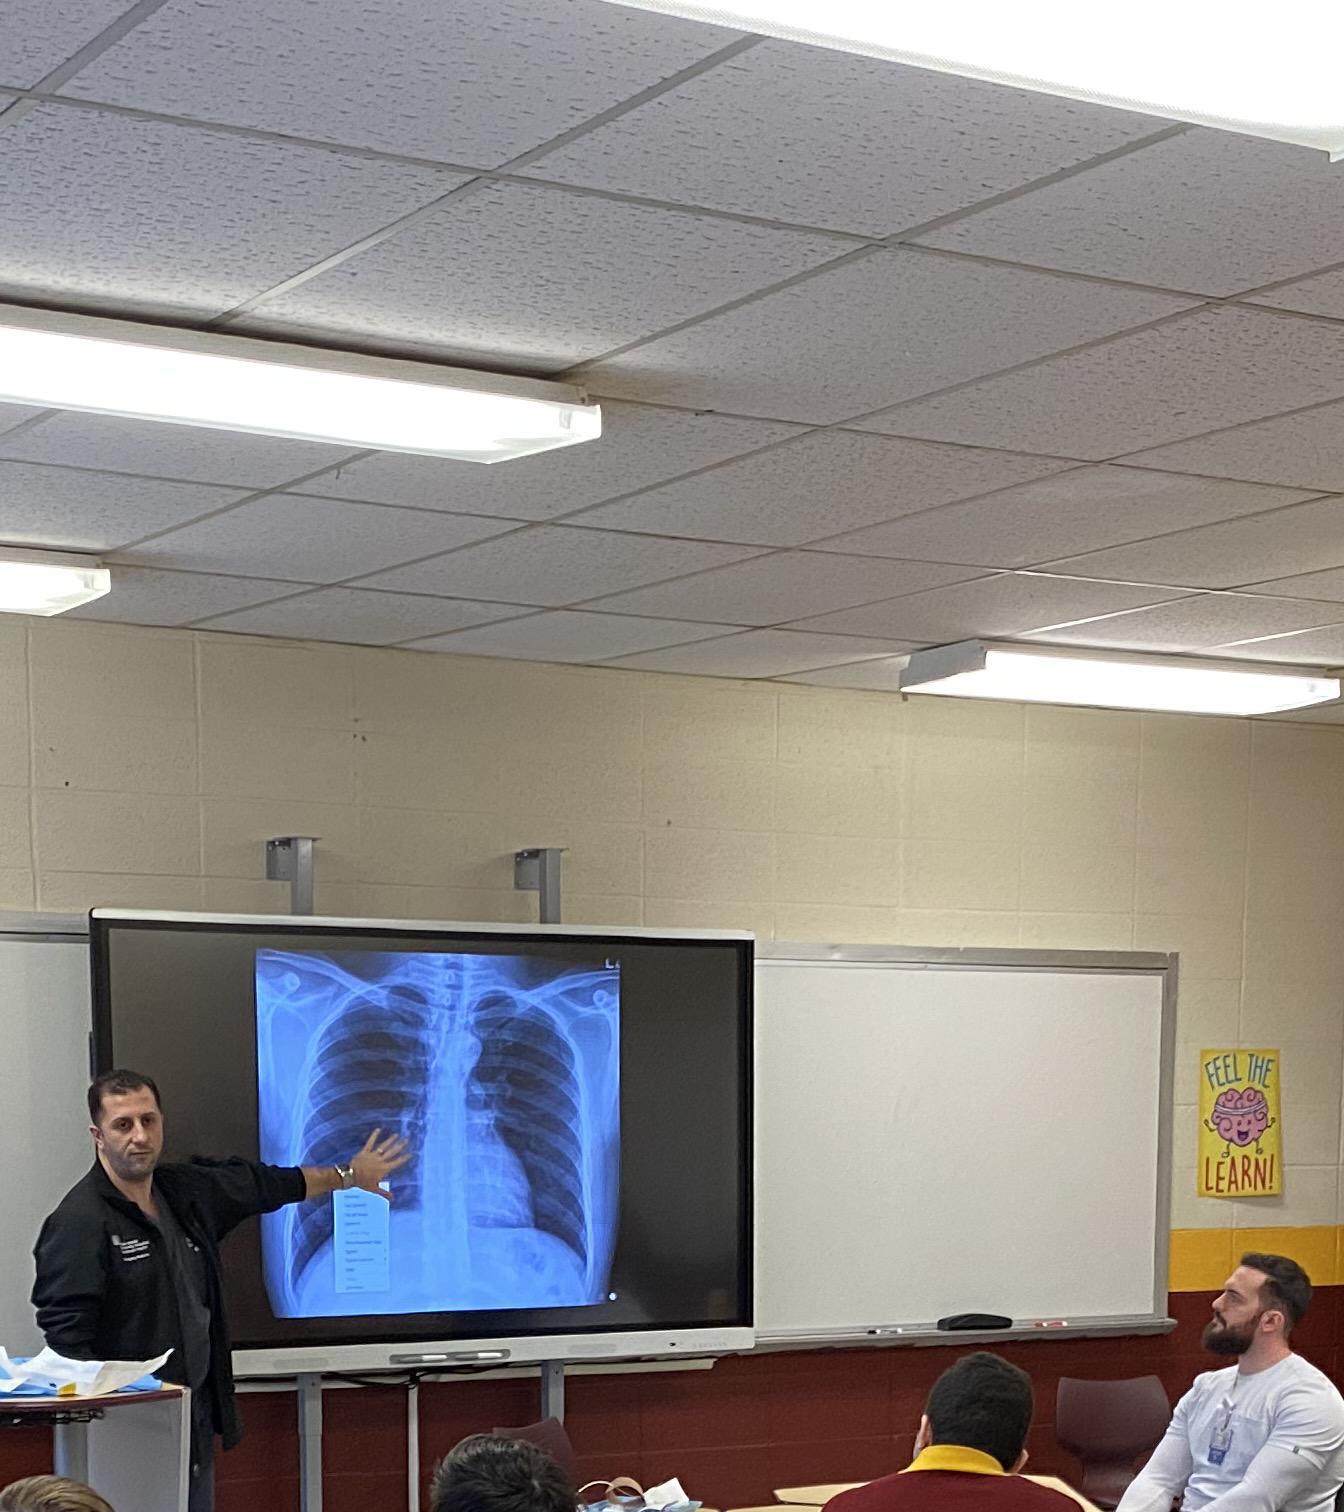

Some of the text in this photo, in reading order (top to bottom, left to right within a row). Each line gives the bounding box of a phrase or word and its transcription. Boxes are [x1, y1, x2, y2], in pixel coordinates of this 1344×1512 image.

[1204, 1053, 1276, 1091] FEEL THE
[1205, 1154, 1275, 1194] LEARN!
